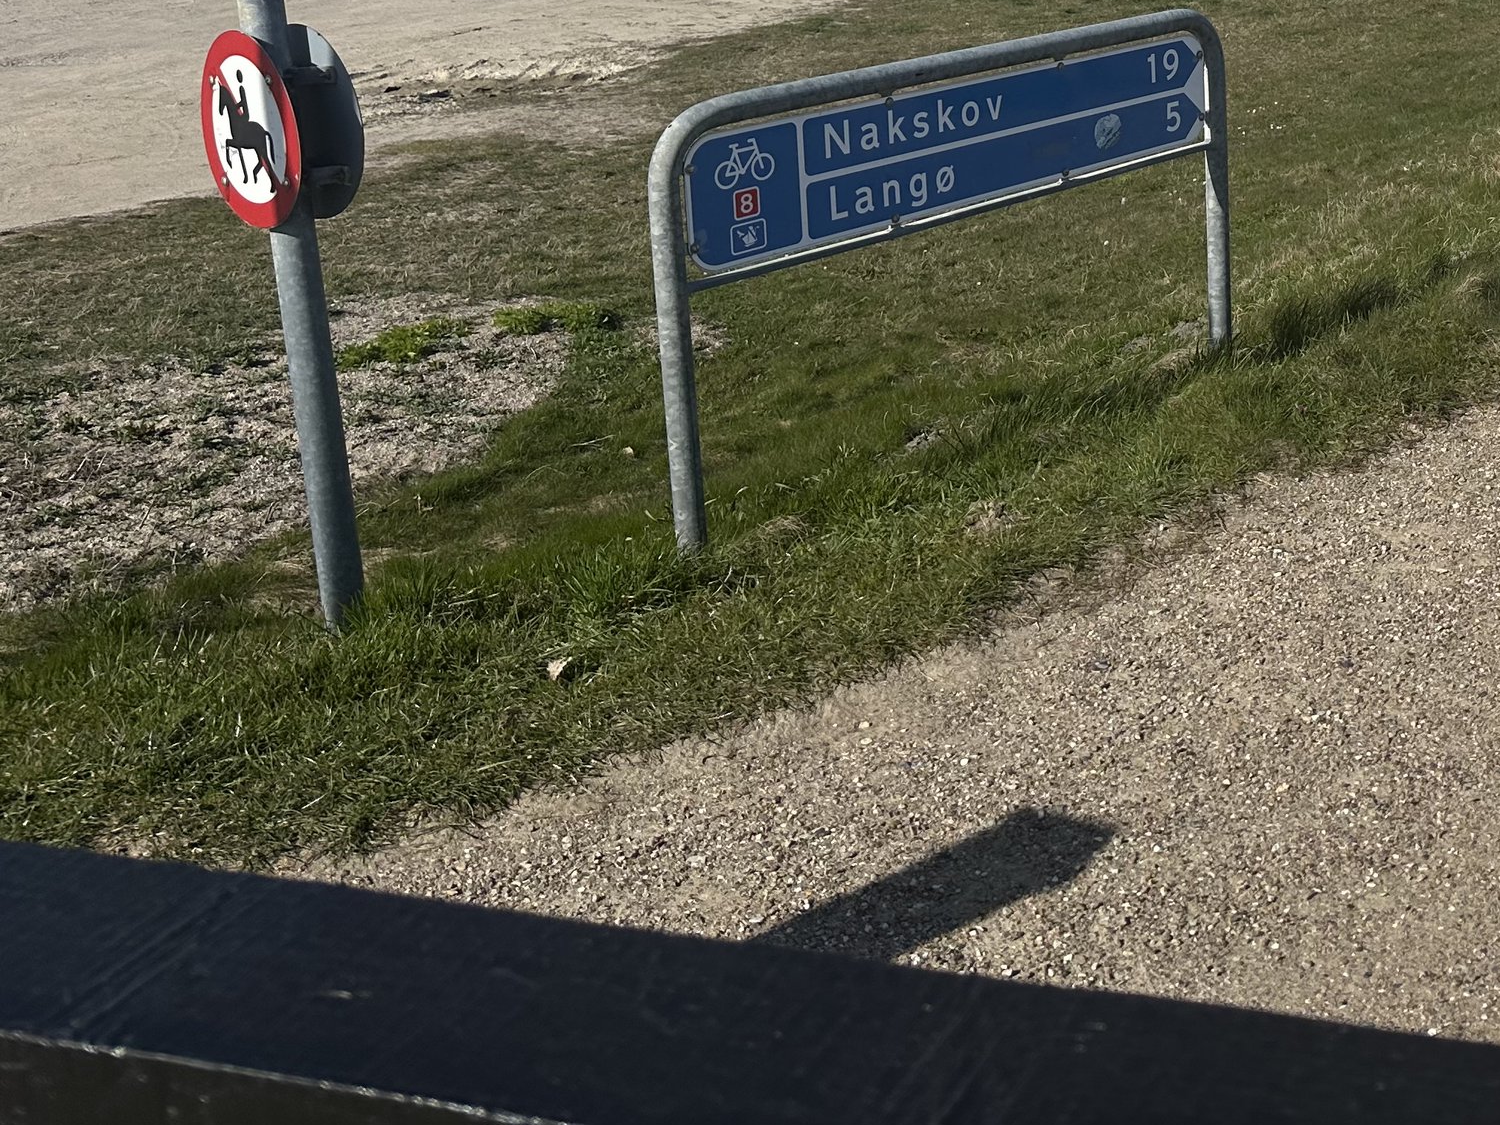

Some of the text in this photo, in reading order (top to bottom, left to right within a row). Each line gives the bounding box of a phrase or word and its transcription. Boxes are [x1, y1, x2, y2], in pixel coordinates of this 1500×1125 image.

[824, 49, 1179, 159] Nakskov 19
[740, 193, 753, 214] 8
[829, 101, 1181, 221] Langø 5
